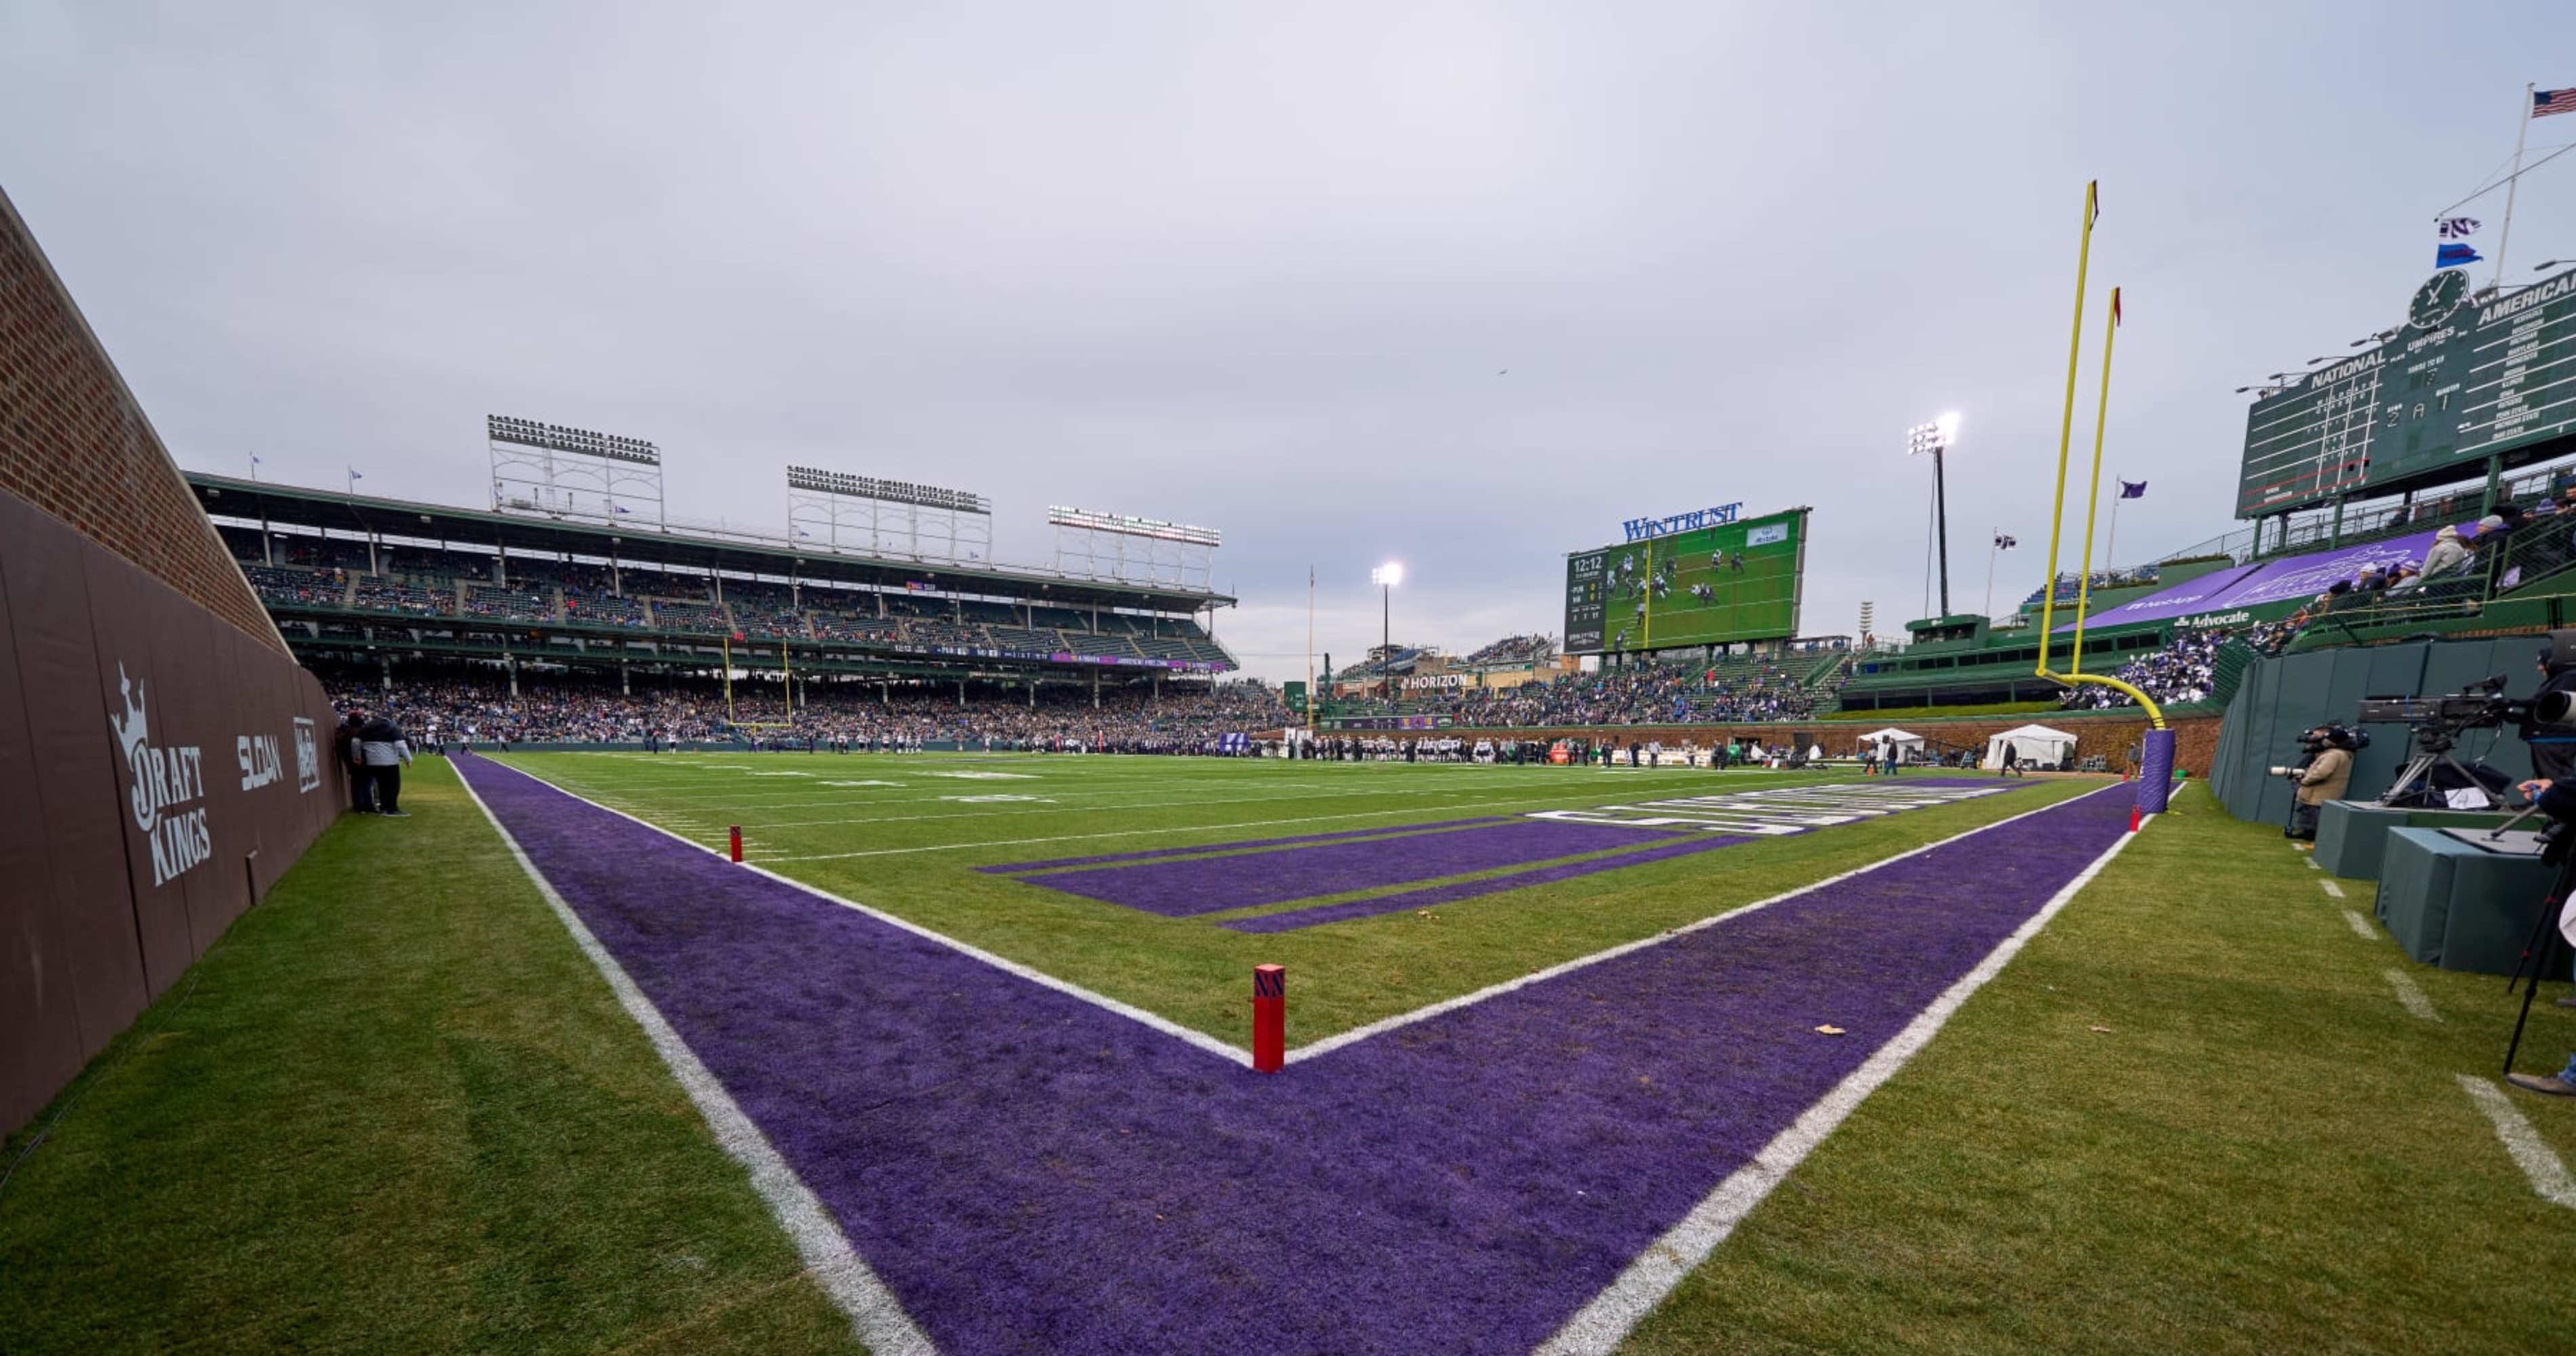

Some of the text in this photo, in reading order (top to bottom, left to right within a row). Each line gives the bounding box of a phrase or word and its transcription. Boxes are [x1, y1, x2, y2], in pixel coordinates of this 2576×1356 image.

[2407, 325, 2455, 351] UMPIRES
[2311, 349, 2386, 390] NATIONAL
[1623, 502, 1743, 541] WINTRUST
[1574, 556, 1602, 572] 12:12
[2192, 610, 2249, 628] Advocate
[1411, 674, 1467, 689] HORIZON
[237, 734, 284, 792] SLOAN
[132, 742, 204, 832] DRAFT
[150, 807, 211, 887] KINGS
